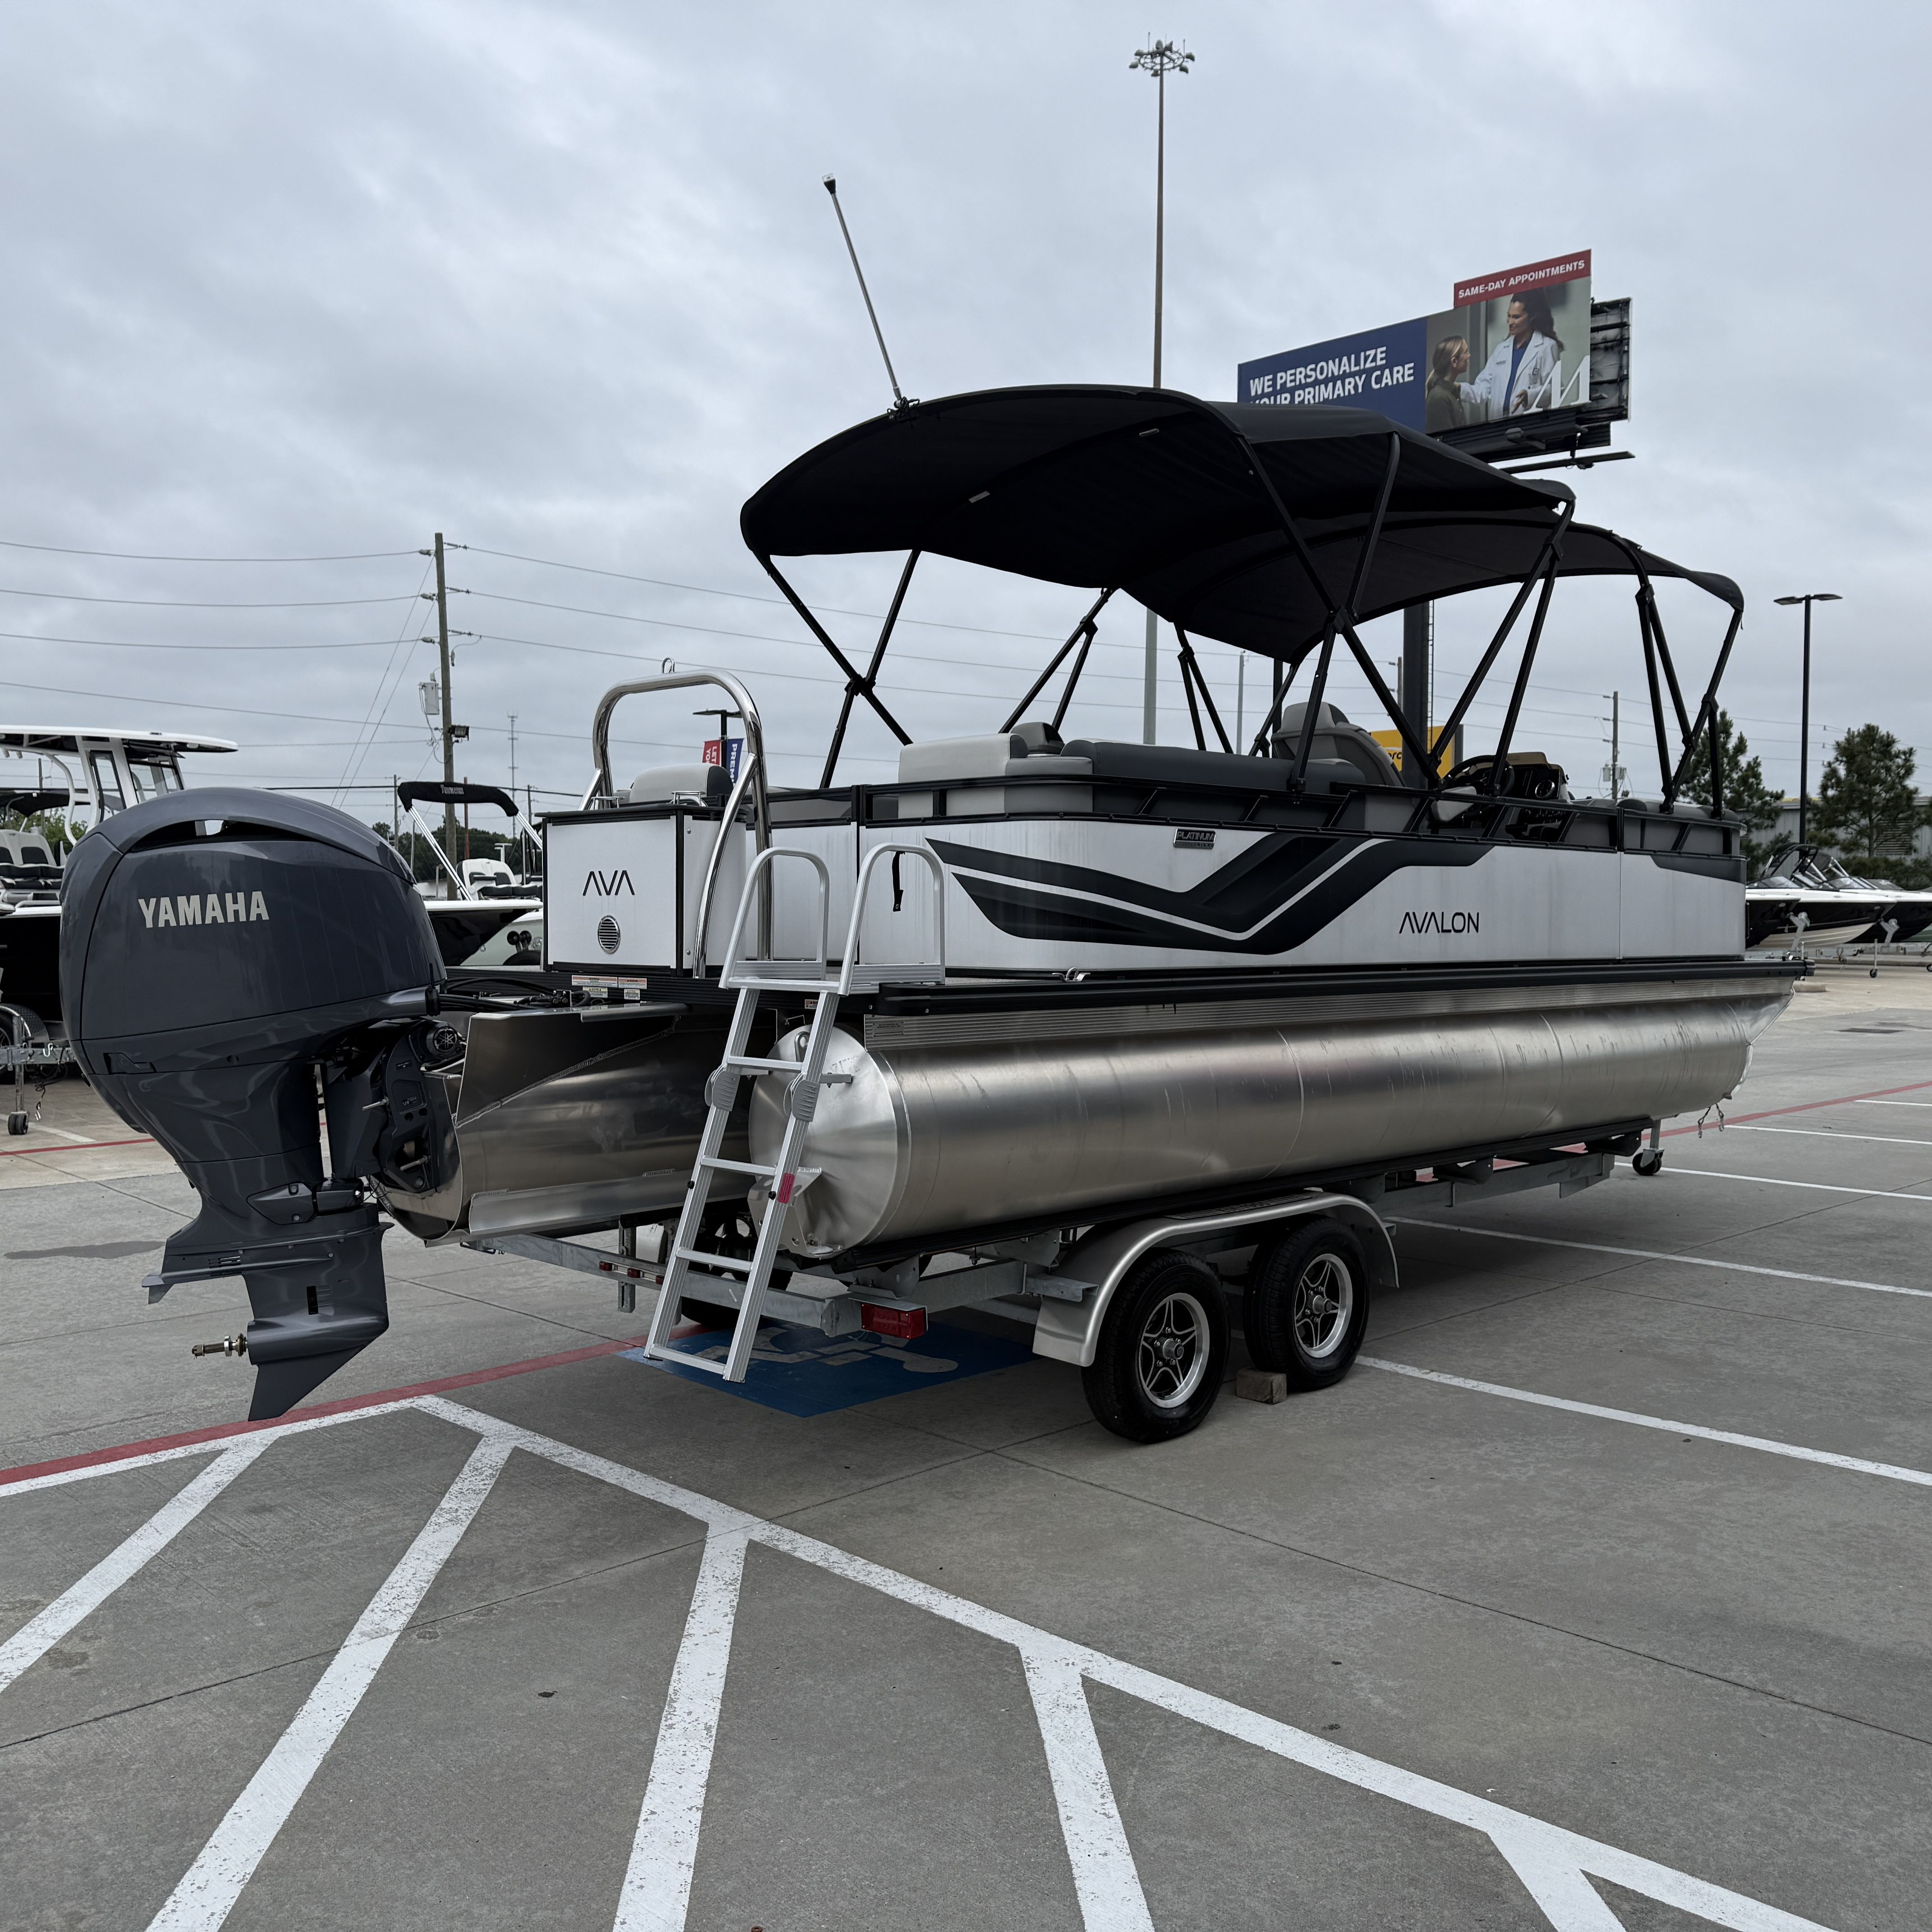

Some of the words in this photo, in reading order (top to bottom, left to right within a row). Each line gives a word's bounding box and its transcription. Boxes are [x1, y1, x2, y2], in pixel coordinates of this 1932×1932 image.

[1458, 278, 1506, 298] SAME-DAY
[1509, 260, 1585, 286] APPOINTMENTS
[1250, 375, 1273, 396] WE
[1277, 346, 1387, 390] PERSONALIZE
[1294, 373, 1366, 405] PRIMARY
[1371, 363, 1414, 389] CARE
[1177, 831, 1214, 841] PLATINUM
[582, 870, 635, 897] AVA
[138, 891, 270, 929] YAMAHA
[1399, 911, 1479, 934] AVALON
